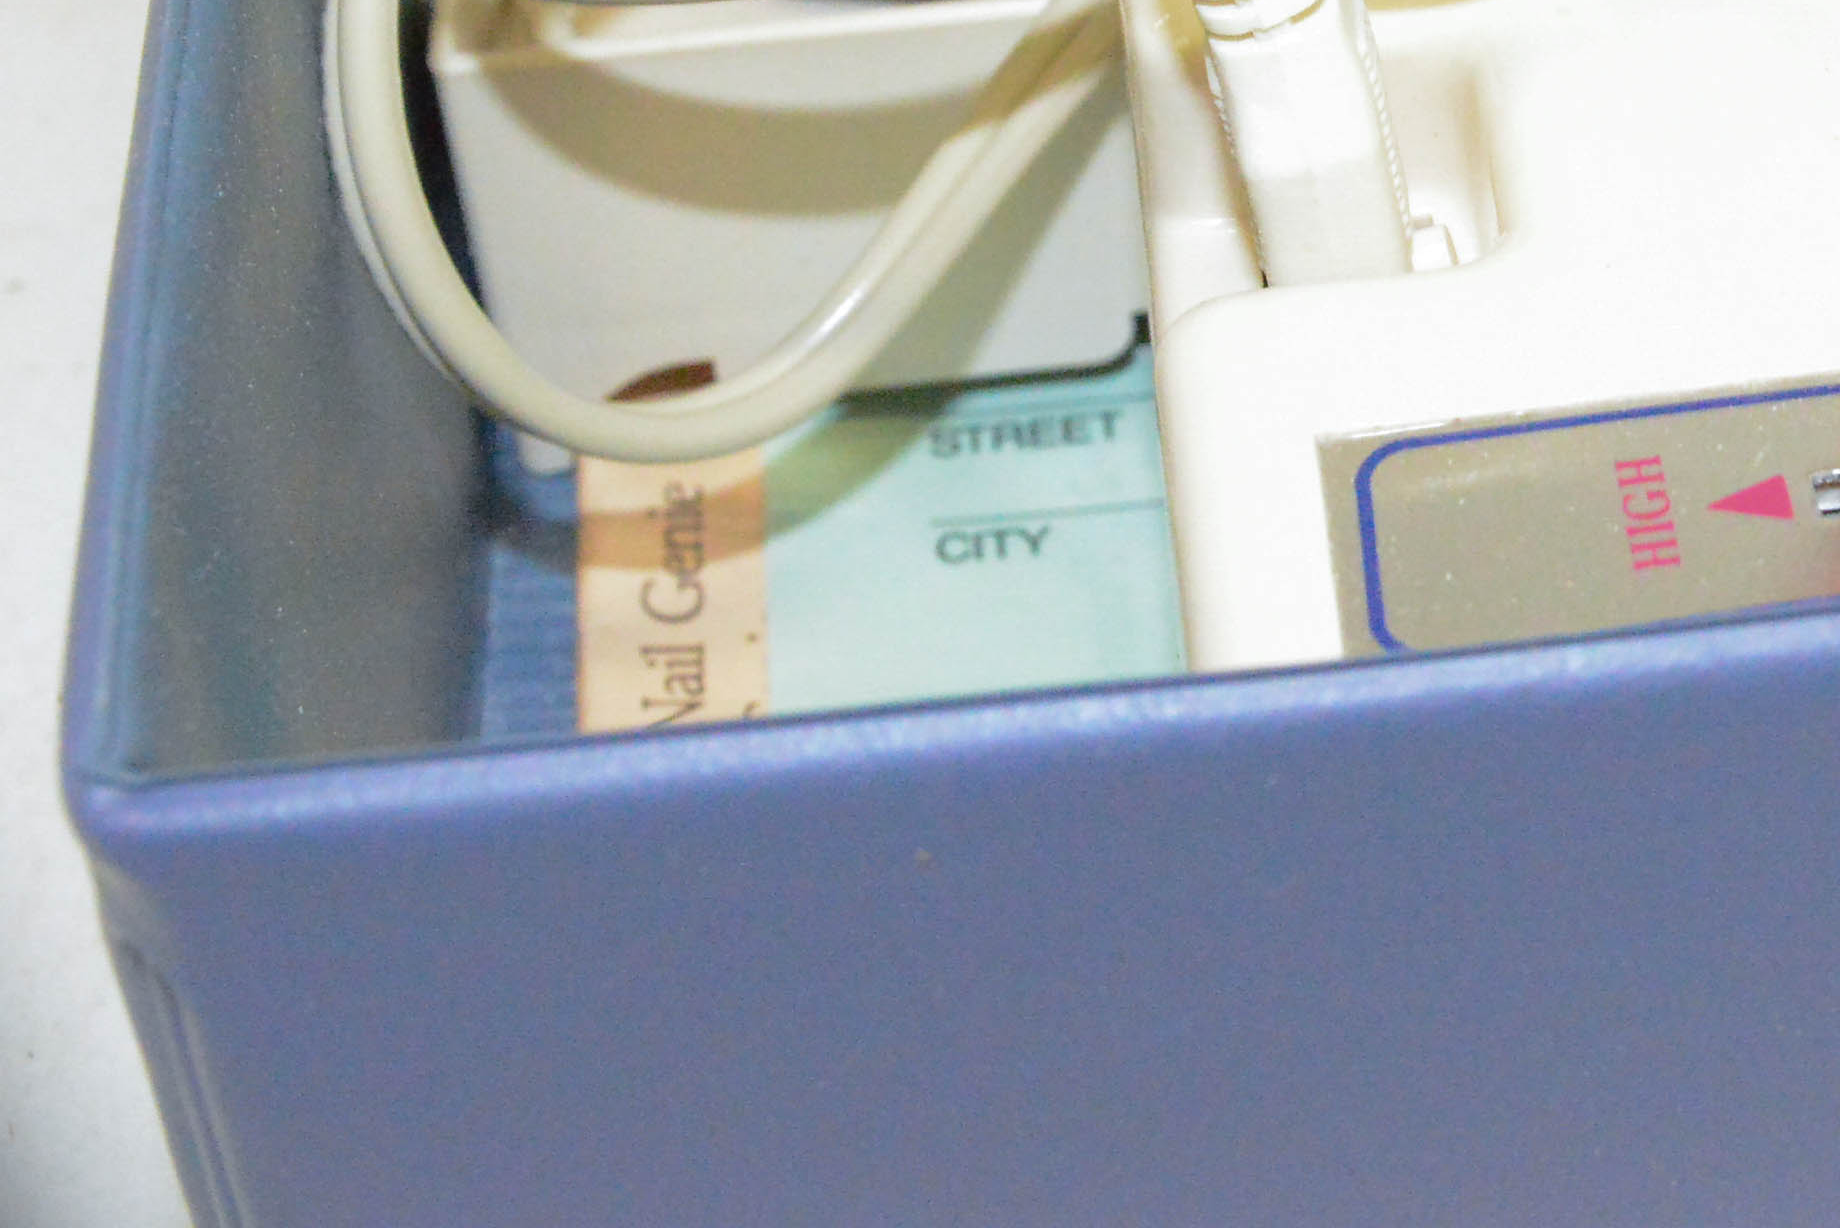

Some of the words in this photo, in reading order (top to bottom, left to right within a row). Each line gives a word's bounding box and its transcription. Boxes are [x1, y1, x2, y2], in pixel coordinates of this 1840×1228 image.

[929, 409, 1121, 461] STREET
[640, 482, 707, 625] Genie
[935, 524, 1052, 564] CITY
[1613, 453, 1682, 572] HIGH
